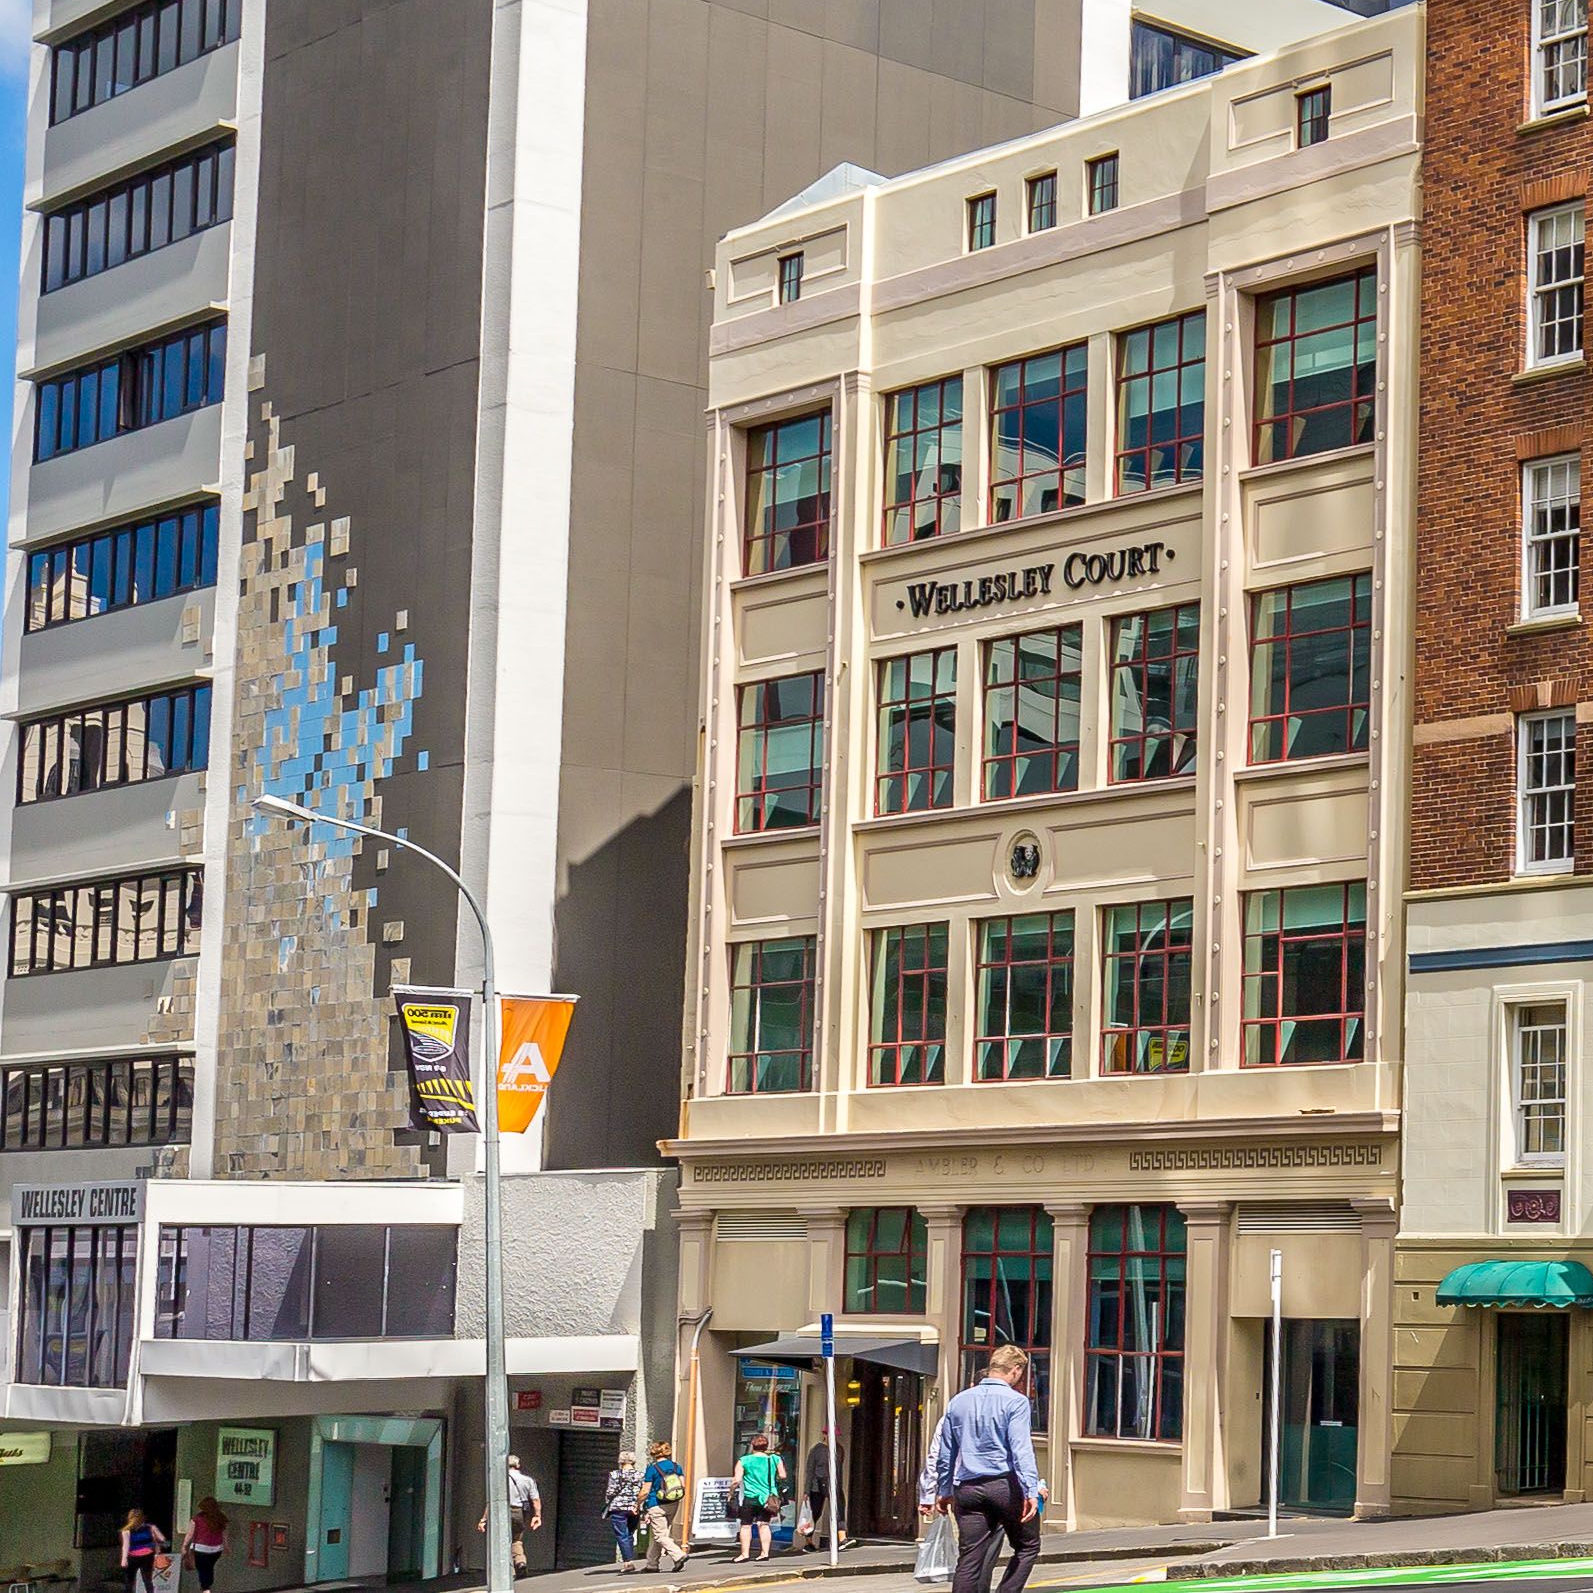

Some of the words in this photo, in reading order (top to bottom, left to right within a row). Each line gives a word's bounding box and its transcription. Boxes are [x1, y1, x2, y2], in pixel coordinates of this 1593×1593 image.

[906, 563, 1055, 619] WELLESLEY
[1063, 541, 1165, 589] COURT
[1022, 1155, 1045, 1173] CO
[21, 1188, 86, 1219] WELLESLEY
[89, 1187, 138, 1218] CENTRE
[221, 1436, 269, 1458] WELLESLEY
[228, 1460, 260, 1480] CENTRE
